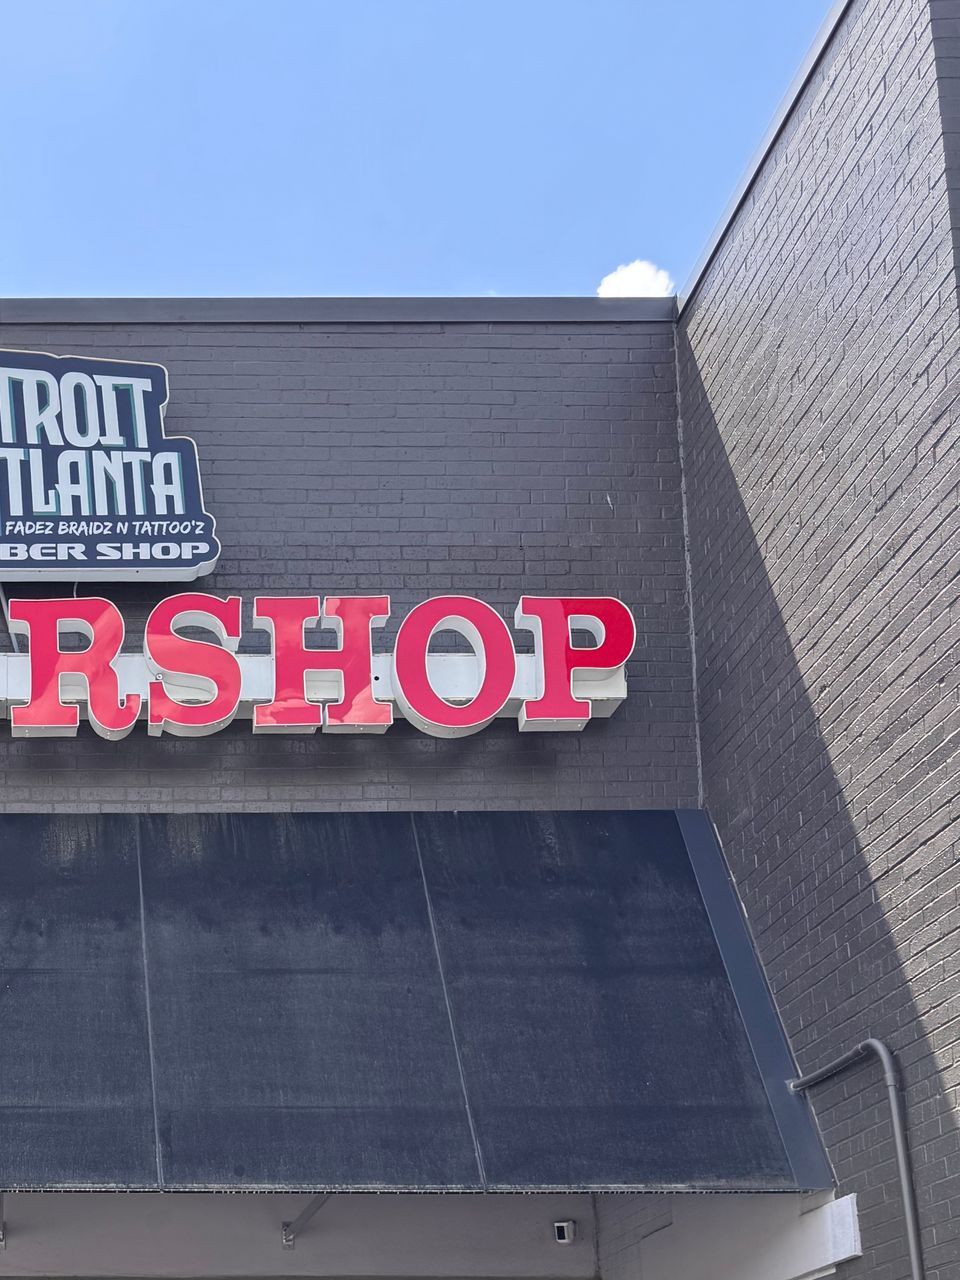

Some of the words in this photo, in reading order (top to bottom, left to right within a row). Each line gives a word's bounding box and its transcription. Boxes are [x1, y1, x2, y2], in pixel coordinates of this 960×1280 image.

[5, 521, 53, 535] FADEZ
[58, 522, 113, 537] BRAIDZ
[117, 521, 129, 535] N
[133, 520, 206, 536] TATTOO'Z
[96, 542, 210, 560] SHOP
